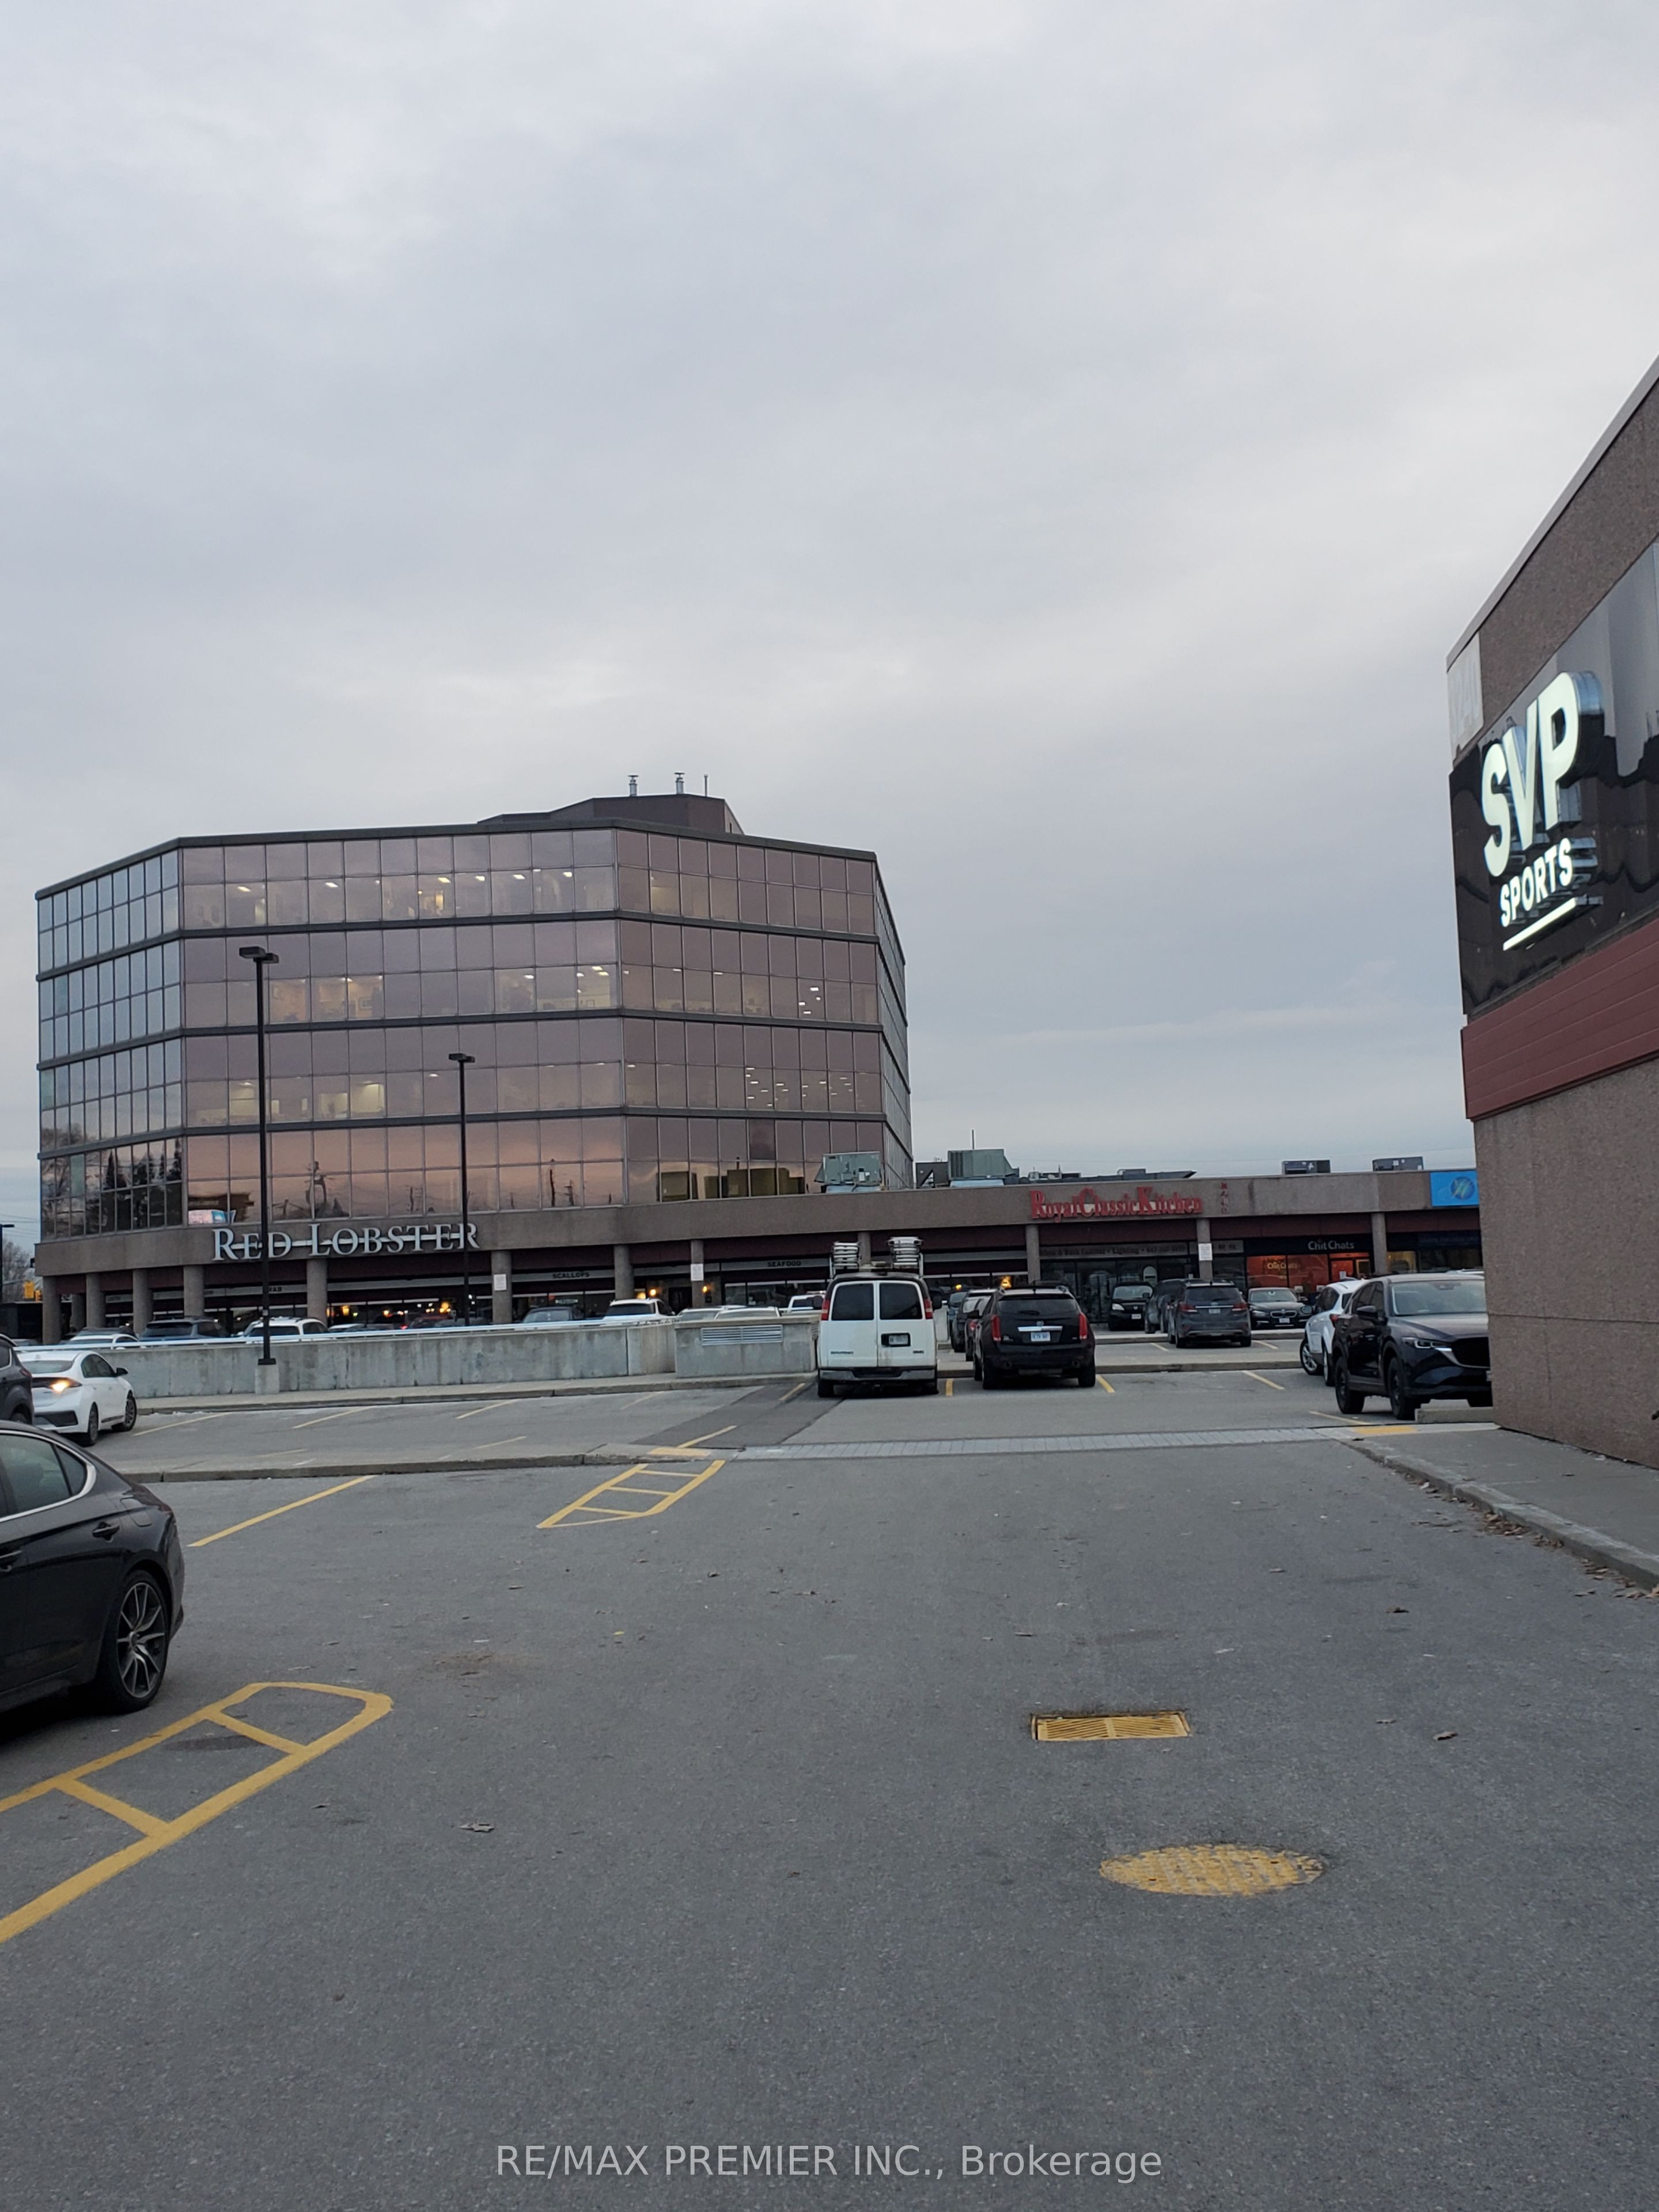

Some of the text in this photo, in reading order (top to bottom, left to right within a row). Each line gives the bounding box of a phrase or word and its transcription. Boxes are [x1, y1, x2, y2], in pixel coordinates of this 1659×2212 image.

[1481, 672, 1580, 877] SVP
[1500, 838, 1573, 927] SPORTS
[1030, 1190, 1077, 1223] Royal
[1078, 1187, 1137, 1217] Classic
[1137, 1187, 1204, 1215] Kitchen
[211, 1223, 480, 1261] RED LOBSTER
[1308, 1239, 1355, 1251] Chit Chats
